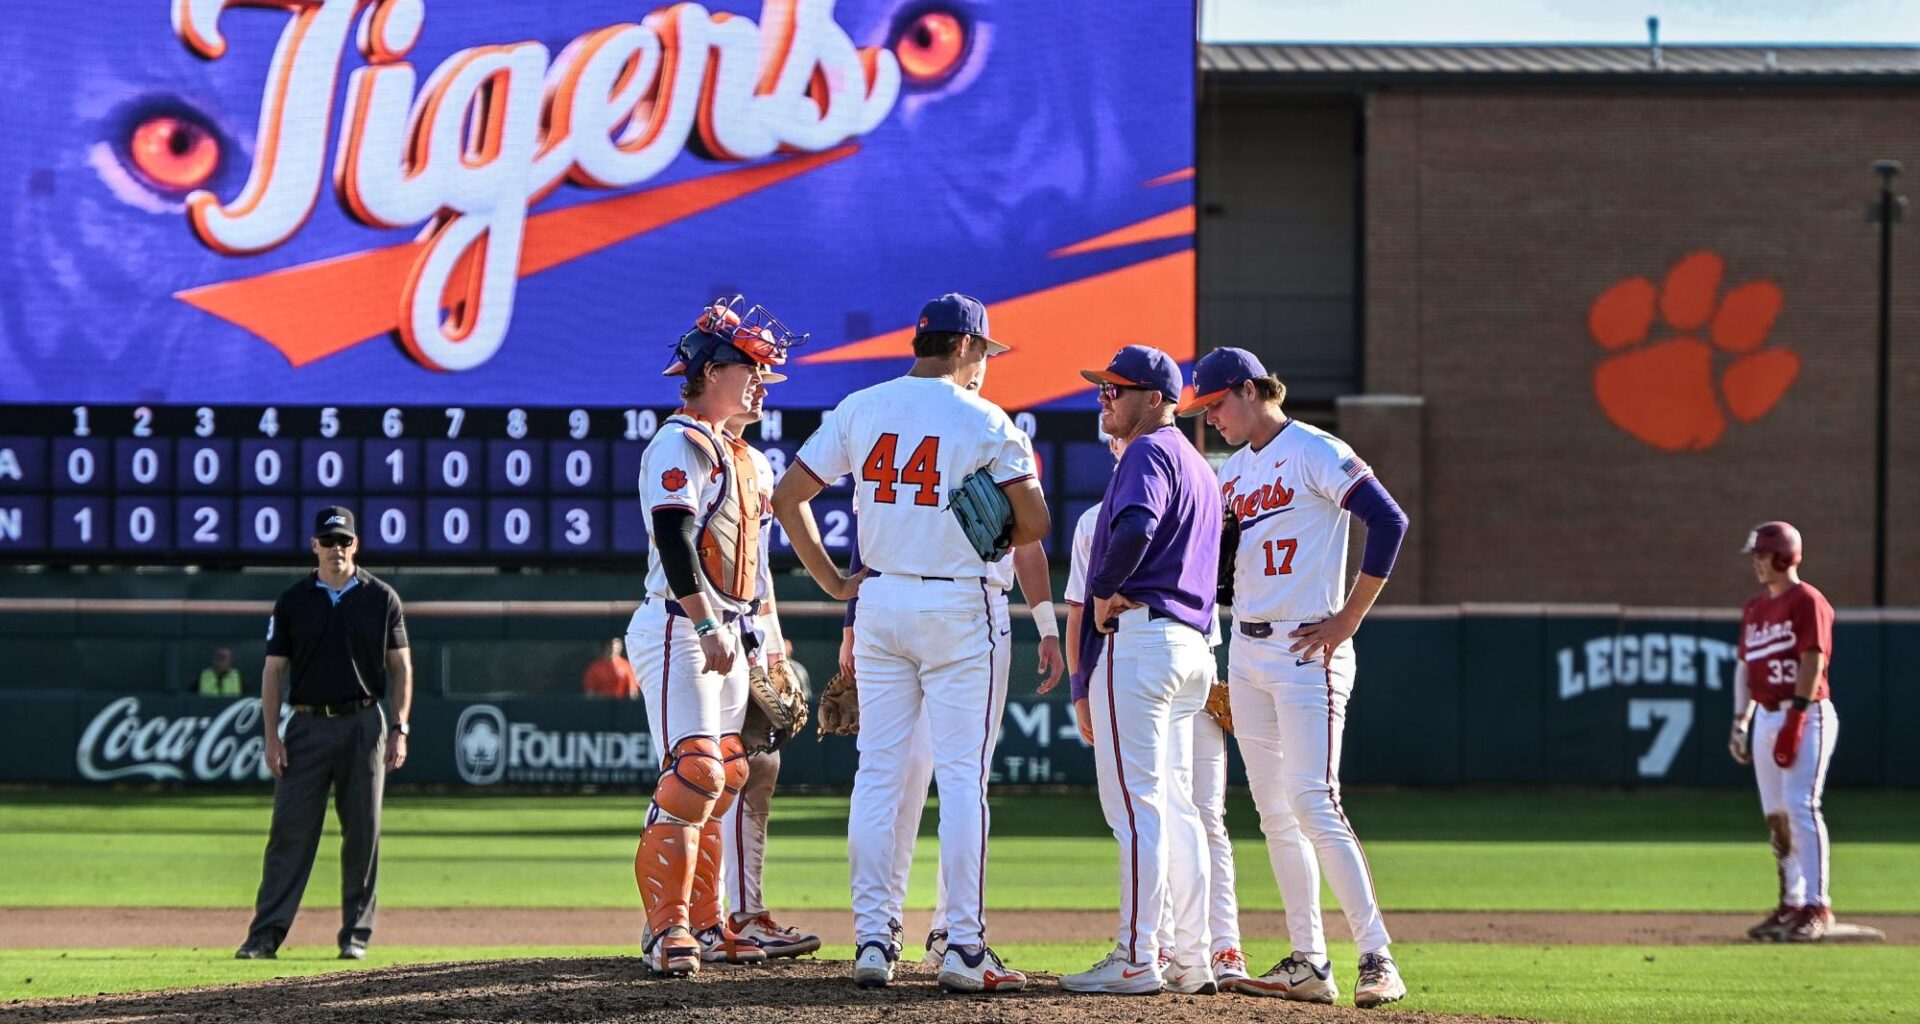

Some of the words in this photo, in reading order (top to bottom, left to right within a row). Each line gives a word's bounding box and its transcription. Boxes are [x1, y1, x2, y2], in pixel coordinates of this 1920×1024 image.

[172, 0, 901, 372] Tigers
[74, 406, 90, 436] 1
[133, 406, 152, 437] 2
[195, 406, 215, 437] 3
[258, 406, 280, 437] 4
[320, 407, 340, 438] 5
[383, 407, 403, 438] 6
[445, 407, 465, 438] 7
[507, 408, 527, 439] 8
[569, 408, 590, 439] 9
[624, 409, 657, 440] 10
[760, 409, 782, 441] H
[68, 448, 94, 484] 0
[132, 448, 158, 484] 0
[194, 448, 219, 484] 0
[255, 449, 281, 485] 0
[317, 451, 343, 487] 0
[385, 449, 403, 485] 1
[443, 451, 468, 487] 0
[506, 450, 531, 486] 0
[566, 450, 591, 486] 0
[862, 432, 941, 507] 44
[74, 508, 91, 542] 1
[130, 507, 155, 542] 0
[193, 507, 219, 542] 2
[255, 507, 280, 543] 0
[380, 508, 406, 544] 0
[443, 508, 469, 544] 0
[504, 508, 530, 544] 0
[565, 509, 591, 544] 3
[824, 510, 849, 546] 2
[1263, 538, 1297, 576] 17
[1557, 632, 1740, 699] LEGGET
[1767, 659, 1798, 684] 33
[76, 696, 297, 780] Coca-Co
[1628, 699, 1693, 777] 7
